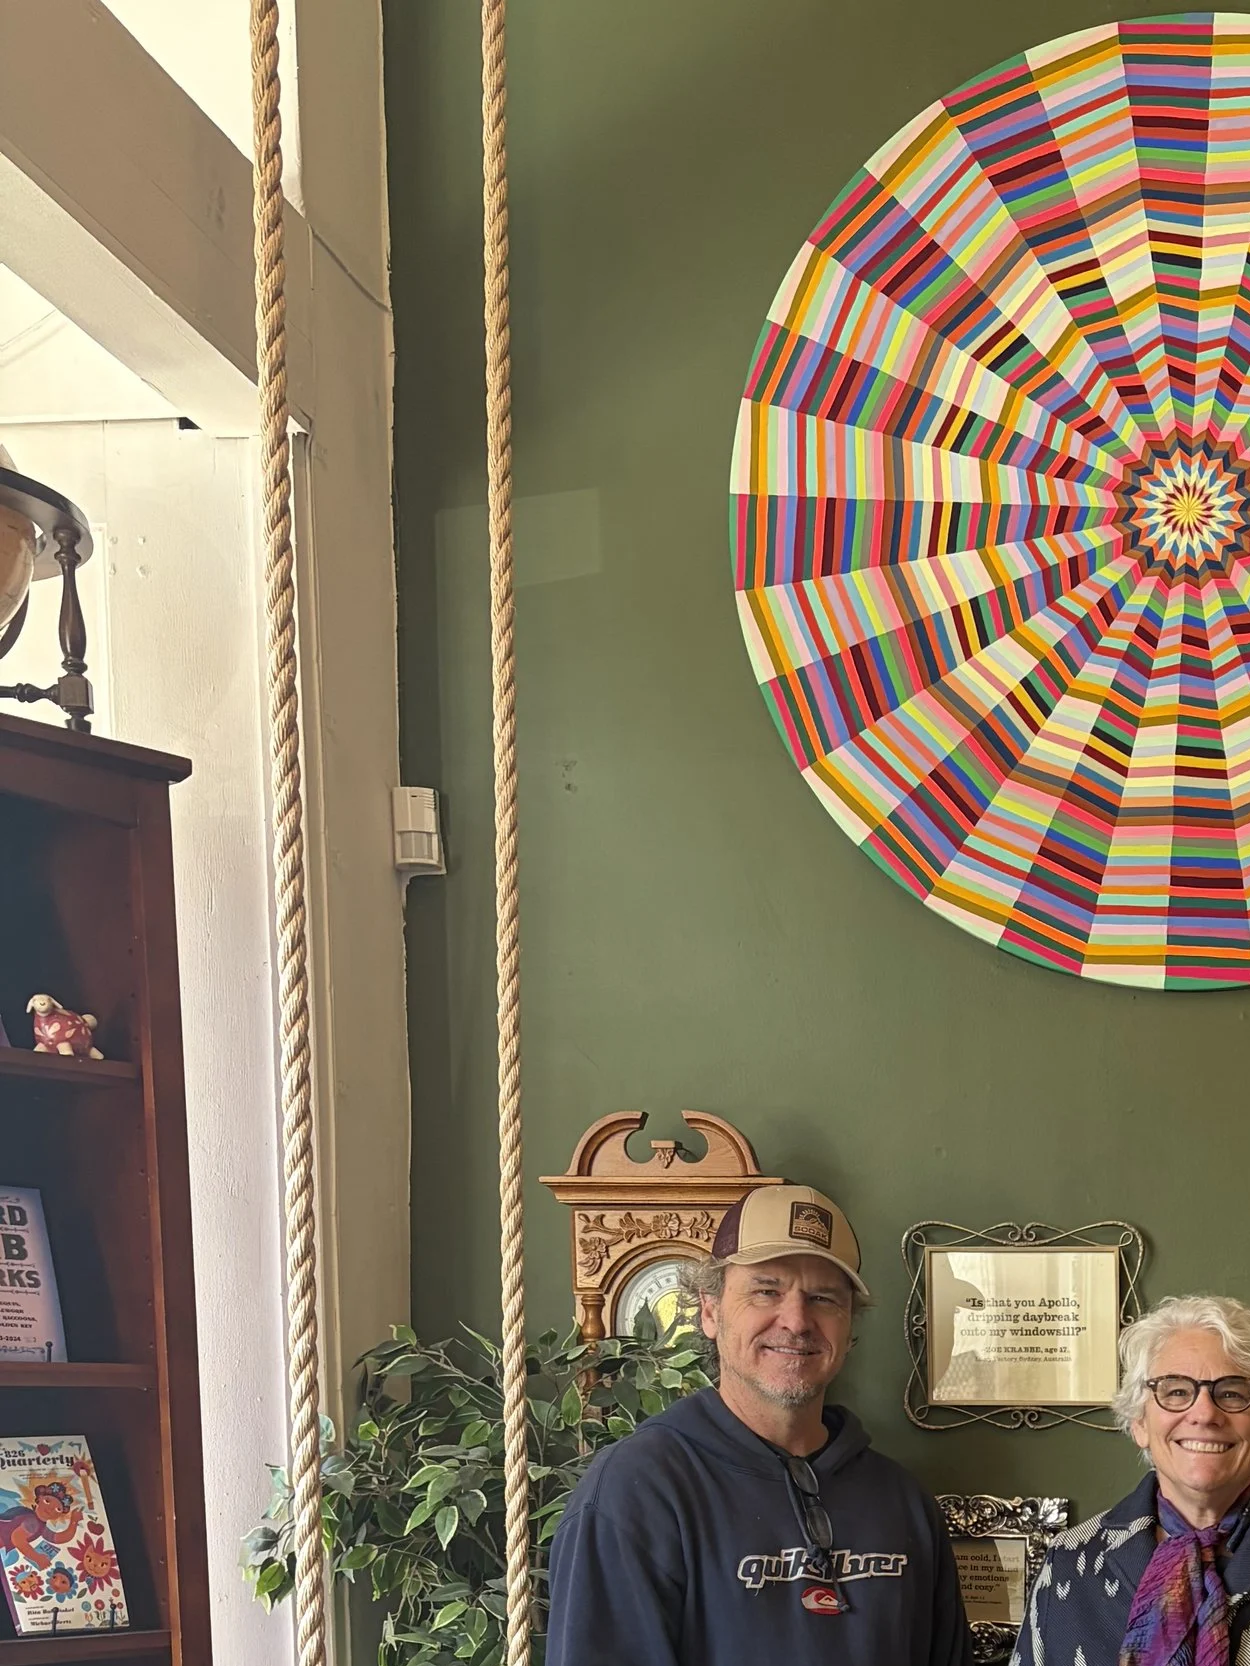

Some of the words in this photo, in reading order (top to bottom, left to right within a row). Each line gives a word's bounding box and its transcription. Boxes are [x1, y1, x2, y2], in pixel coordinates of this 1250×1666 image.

[966, 1298, 984, 1307] “Is
[986, 1298, 1011, 1307] that
[1014, 1300, 1035, 1309] you
[1038, 1298, 1080, 1309] Apollo,
[967, 1312, 1020, 1323] dripping
[1022, 1312, 1080, 1323] daybreak
[960, 1328, 986, 1336] onto
[989, 1329, 1007, 1338] my
[1010, 1327, 1087, 1337] windowsill?”
